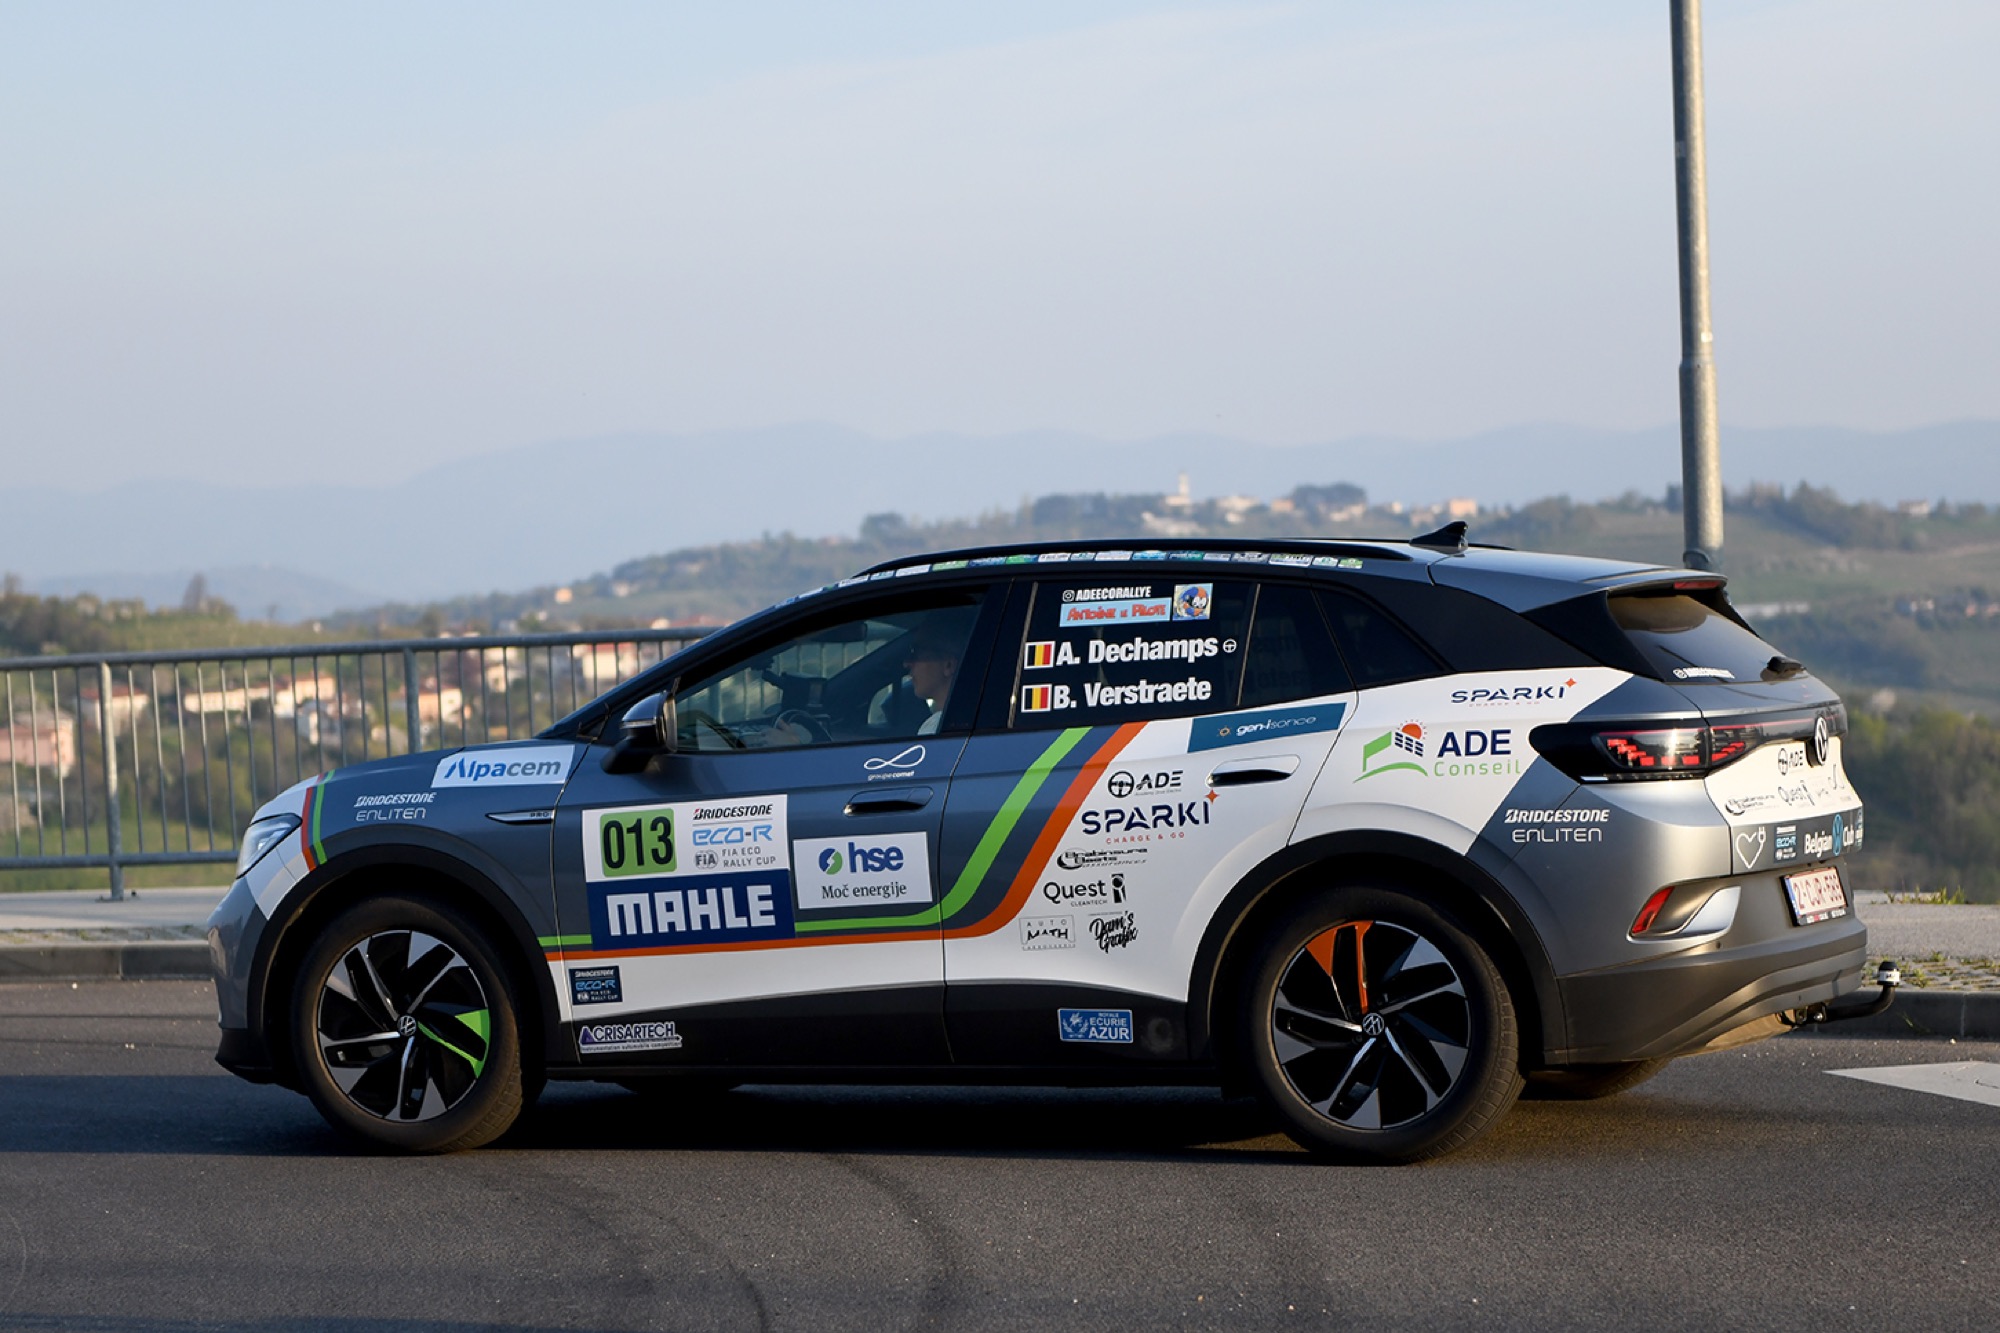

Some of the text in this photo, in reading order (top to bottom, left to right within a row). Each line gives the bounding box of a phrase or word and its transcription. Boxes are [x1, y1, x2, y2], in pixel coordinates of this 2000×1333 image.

[1075, 586, 1152, 602] ADEECORALLYE
[1056, 637, 1218, 666] A. Dechamps
[1053, 677, 1212, 709] B. Verstraete
[1450, 687, 1565, 704] SPARKI
[1437, 729, 1512, 758] ADE
[444, 757, 561, 782] Alpacem
[1434, 759, 1521, 777] Conseil
[1136, 770, 1183, 790] ADE
[353, 792, 437, 807] BRIDGESTONE
[356, 807, 427, 822] ENLITEN
[693, 804, 773, 821] BRIDGESTONE
[1081, 801, 1210, 835] SPARKI
[1504, 809, 1611, 823] BRIDGESTONE
[603, 816, 674, 869] 013
[1512, 828, 1602, 843] ENLITEN
[1804, 830, 1832, 858] Belgian
[722, 846, 761, 856] FIA ECO
[848, 842, 904, 873] hse
[723, 856, 777, 868] RALLY CUP
[822, 881, 907, 899] Moč energije
[1043, 879, 1108, 904] Quest
[606, 884, 776, 936] MAHLE
[1070, 899, 1108, 907] CLEANTECH
[1026, 918, 1067, 927] AUTO
[1026, 928, 1069, 941] MATH
[1089, 1017, 1127, 1027] ECURIE
[1089, 1027, 1130, 1040] AZUR
